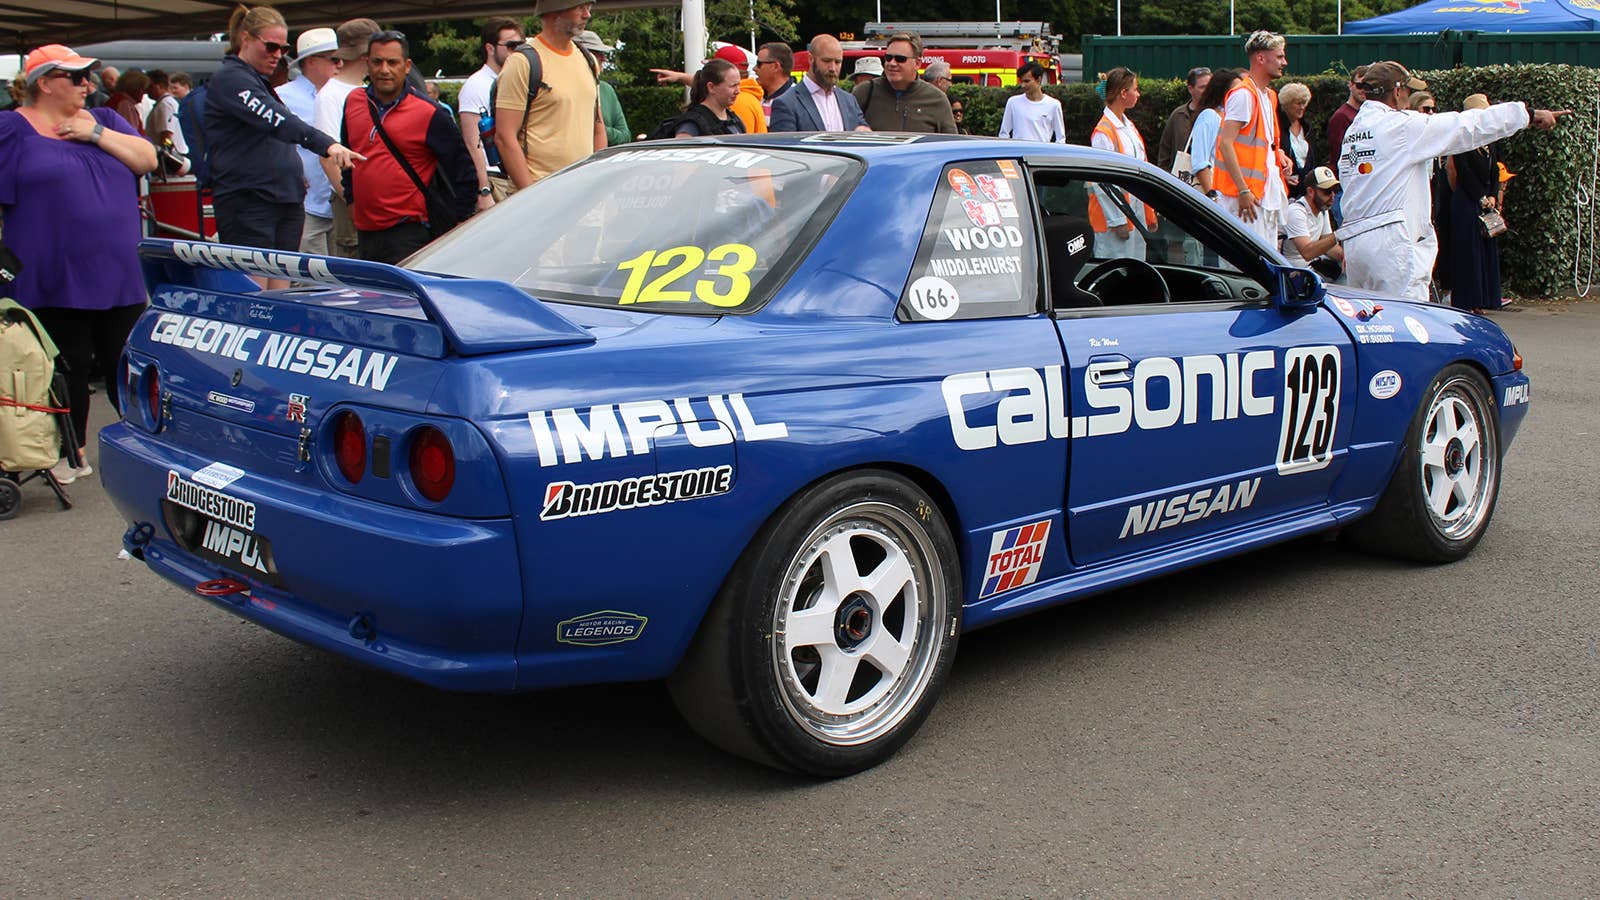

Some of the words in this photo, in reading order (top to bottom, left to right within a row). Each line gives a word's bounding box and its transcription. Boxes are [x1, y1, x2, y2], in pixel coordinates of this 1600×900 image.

[238, 89, 286, 127] ARIAT
[1342, 131, 1374, 144] ARSHAL
[600, 147, 771, 169] NISSAN
[944, 225, 1024, 251] WOOD
[1068, 236, 1085, 254] OMP
[616, 243, 757, 308] 123
[930, 256, 1022, 277] MIDDLEHURST
[915, 287, 948, 310] 166
[257, 333, 399, 391] NISSAN
[289, 392, 311, 403] GT
[1283, 353, 1338, 463] 123
[286, 403, 306, 423] R
[528, 393, 789, 467] IMPUL
[168, 470, 256, 531] BRIDGESTONE
[540, 465, 733, 521] BRIDGESTONE
[1118, 477, 1261, 539] NISSAN
[990, 543, 1042, 575] TOTAL
[566, 625, 634, 637] LEGENDS
